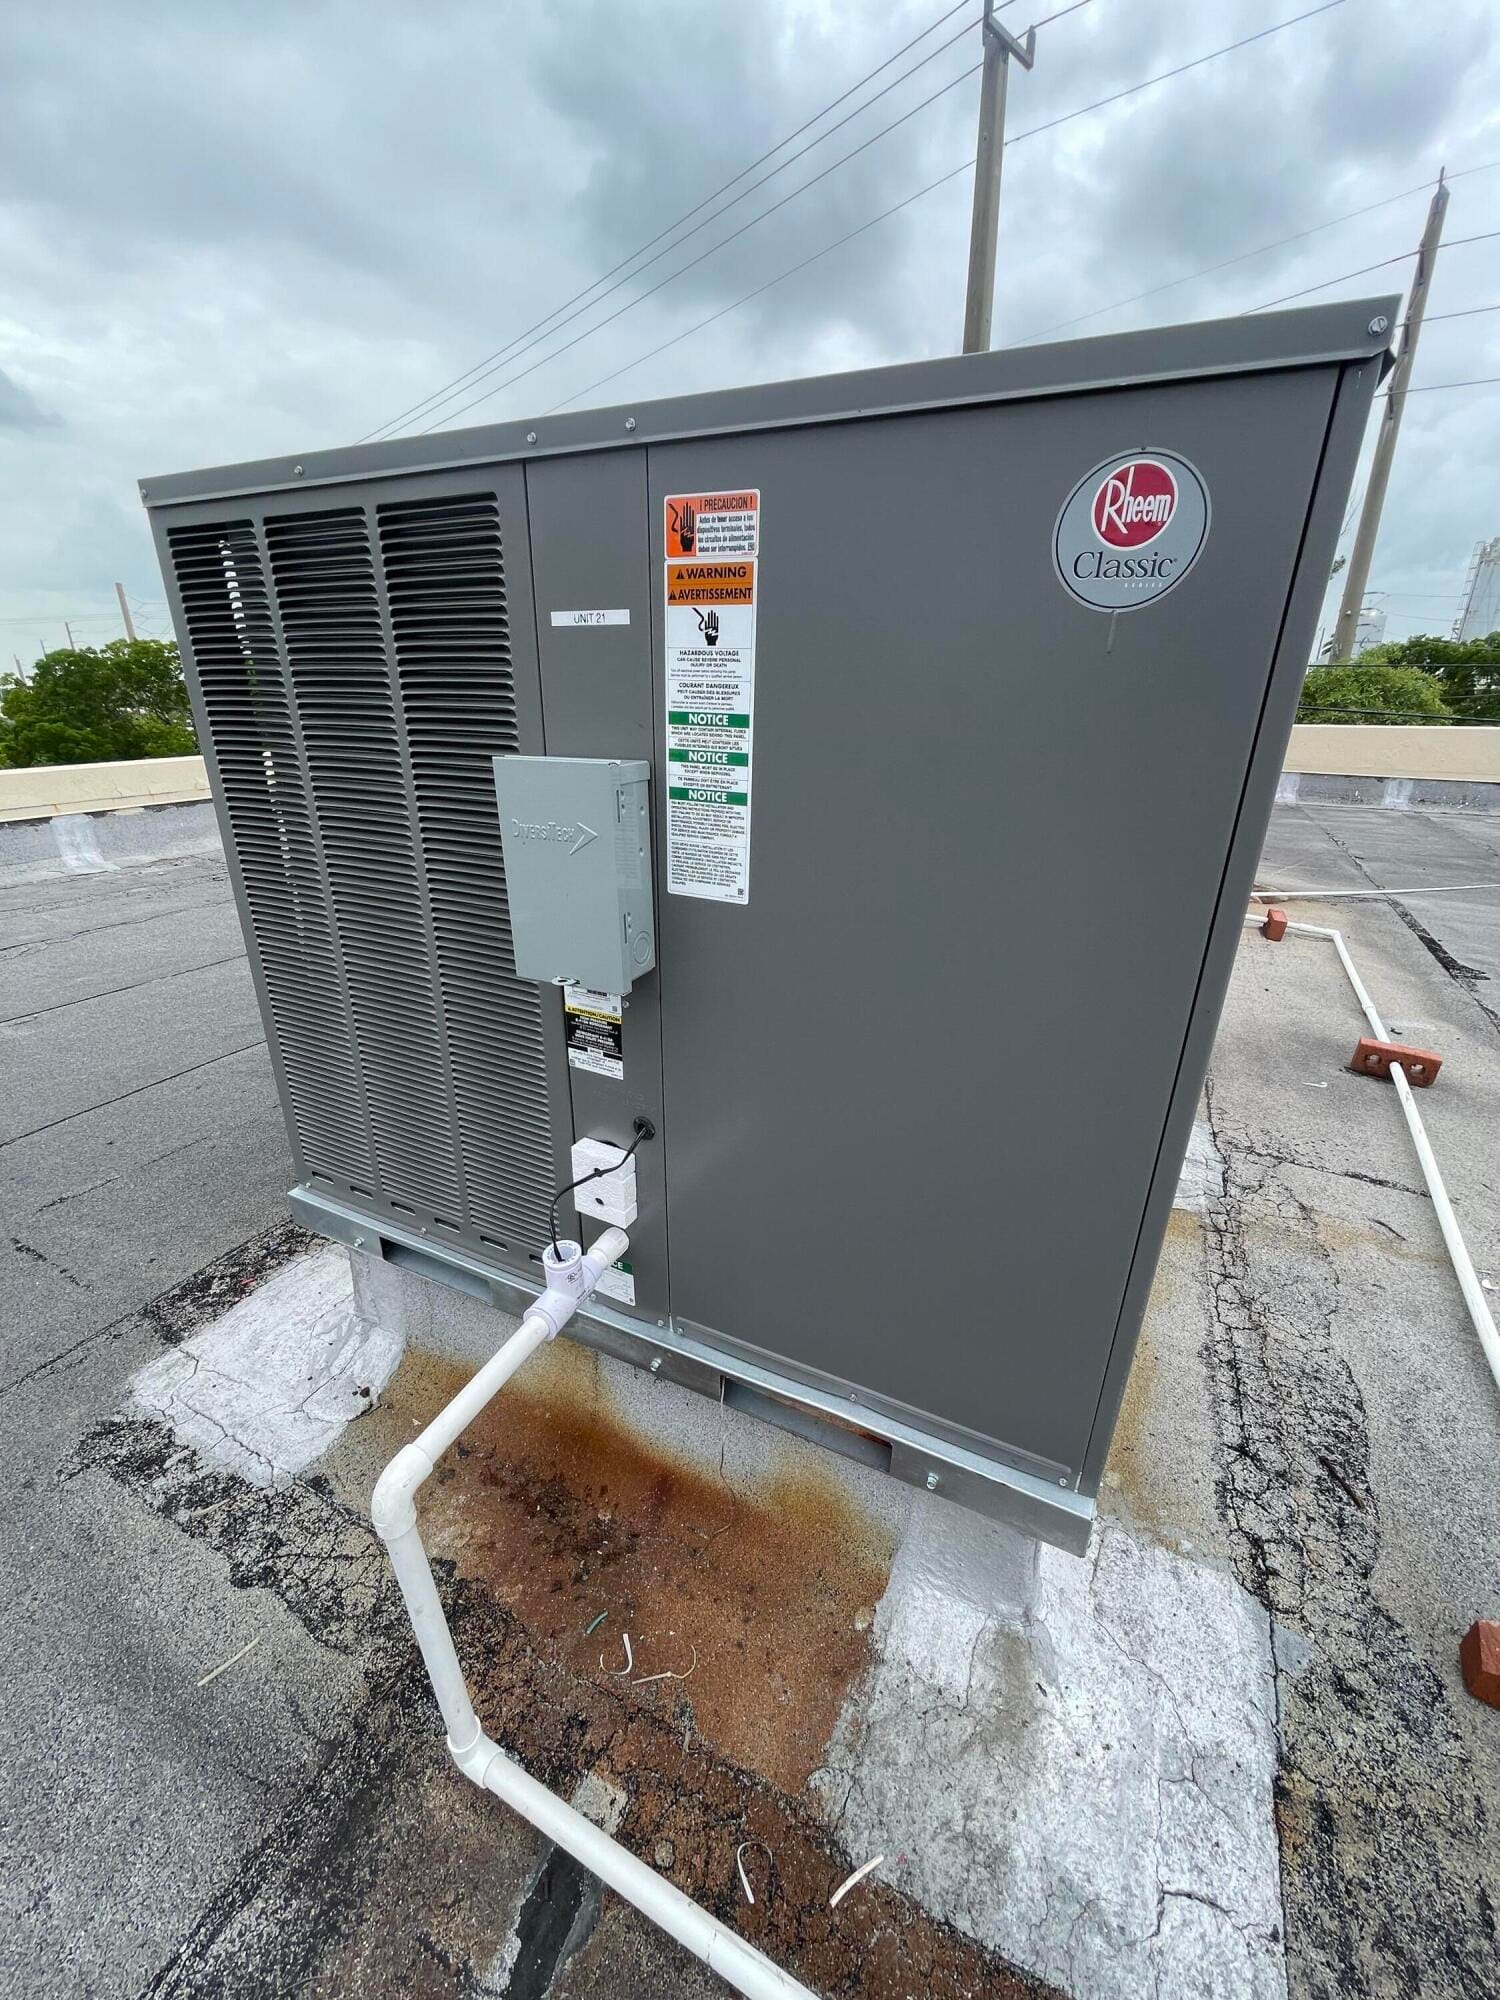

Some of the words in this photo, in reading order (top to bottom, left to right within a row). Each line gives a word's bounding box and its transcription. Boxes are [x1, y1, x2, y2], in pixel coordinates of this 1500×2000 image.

[1101, 466, 1172, 534] Rheem
[1073, 551, 1173, 579] Classic
[686, 566, 747, 579] WARNING
[678, 588, 752, 600] AVERTISSEMENT
[574, 613, 594, 624] UNIT
[596, 612, 606, 624] 21
[688, 713, 729, 726] NOTICE
[688, 751, 728, 764] NOTICE
[688, 790, 728, 802] NOTICE
